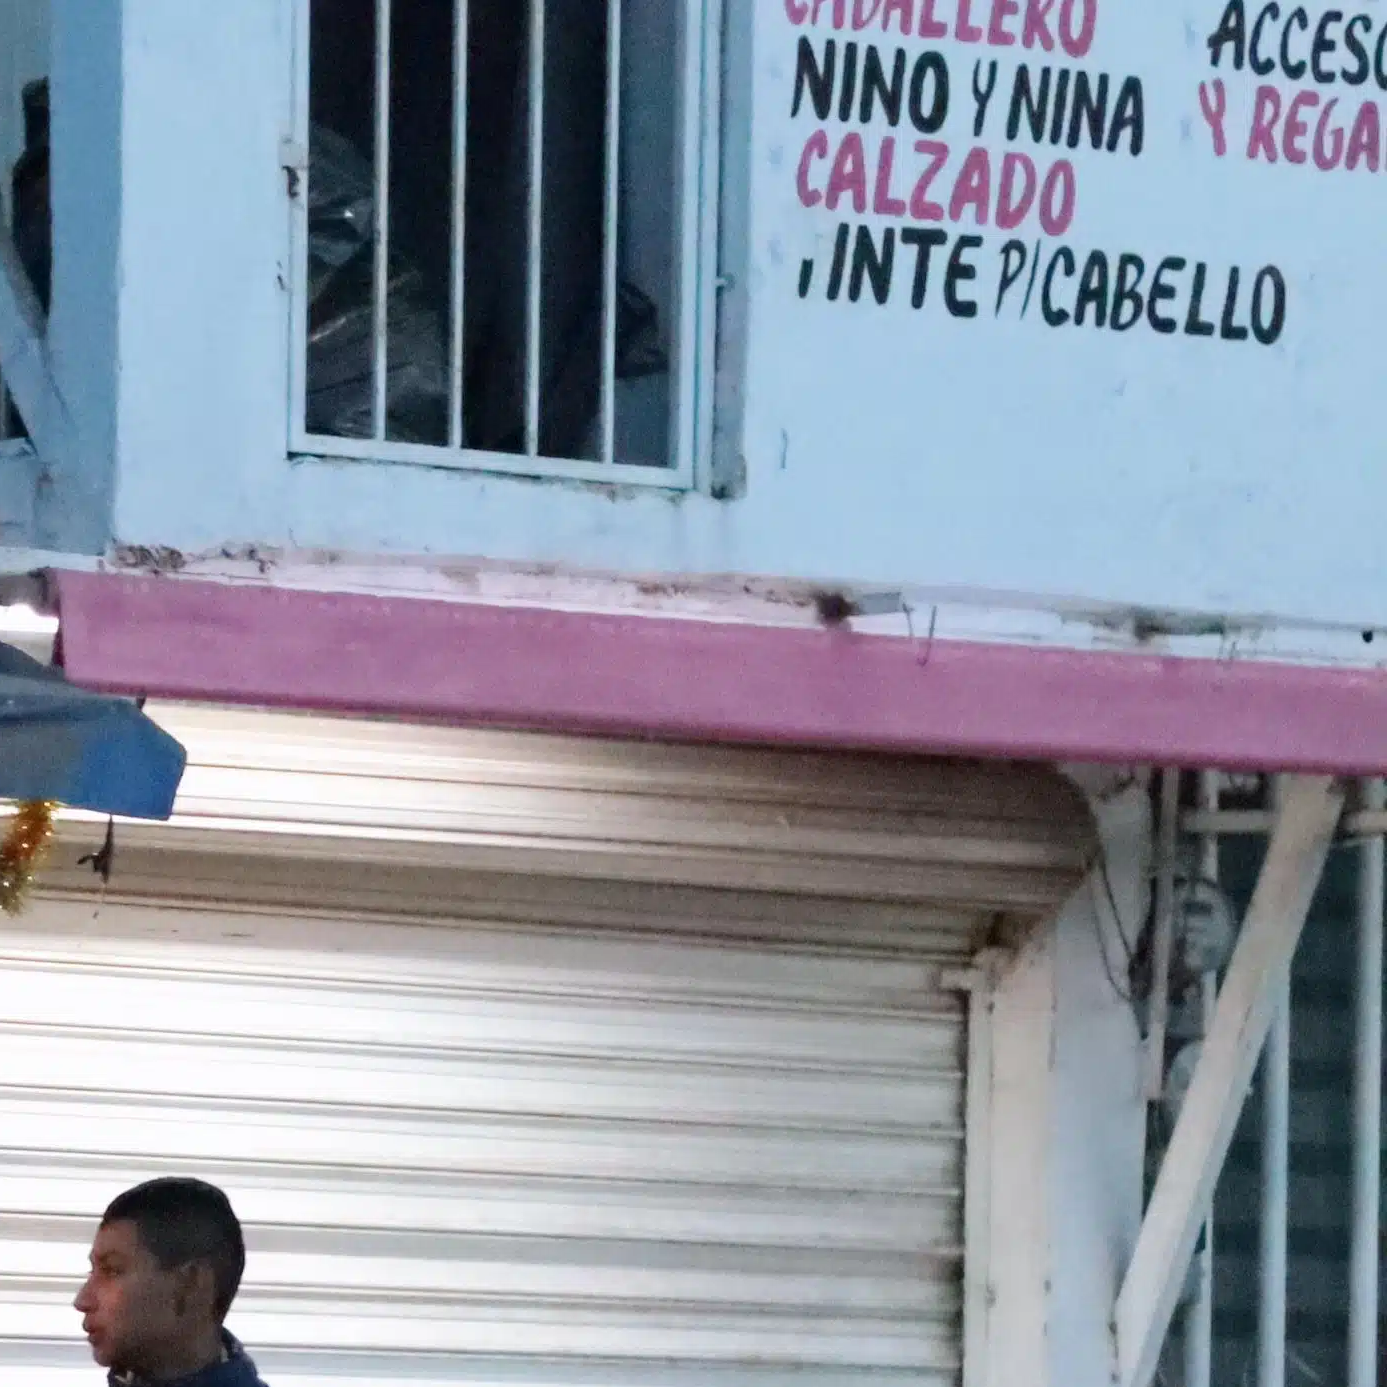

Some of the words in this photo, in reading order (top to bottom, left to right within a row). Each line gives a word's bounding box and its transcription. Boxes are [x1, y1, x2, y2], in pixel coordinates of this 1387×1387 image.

[790, 34, 950, 134] NINO
[971, 57, 998, 138] Y
[1005, 62, 1144, 157] NINA
[1198, 77, 1227, 158] Y
[1245, 84, 1387, 173] REGA
[795, 128, 1077, 237] CALZADO
